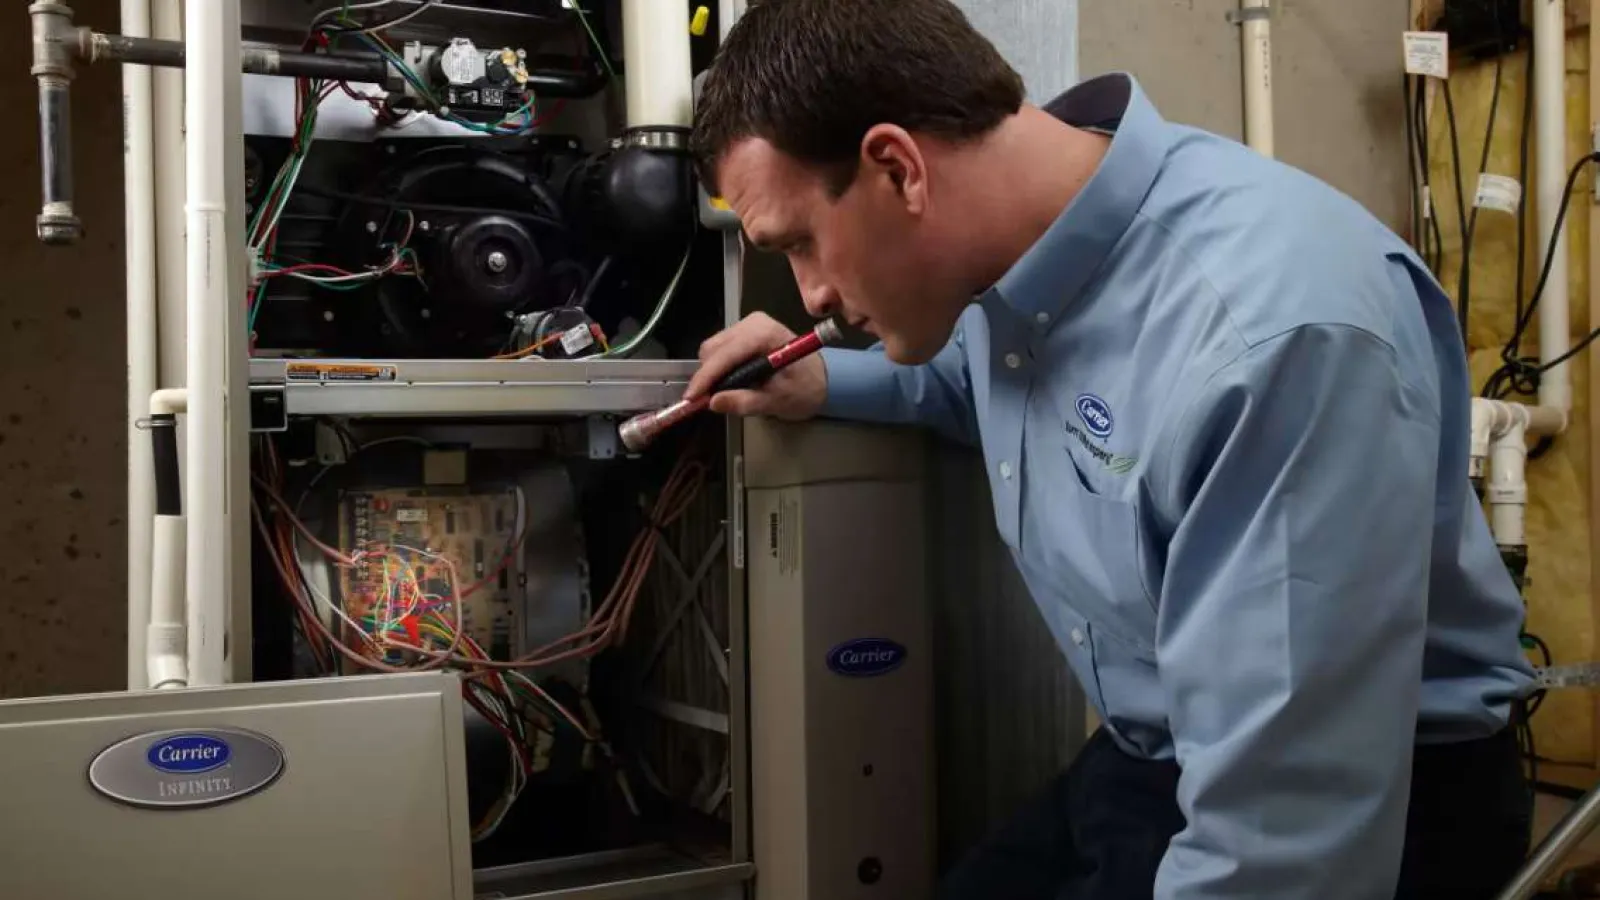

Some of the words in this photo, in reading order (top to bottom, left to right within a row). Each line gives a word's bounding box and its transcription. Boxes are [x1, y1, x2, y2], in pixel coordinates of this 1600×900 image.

[840, 646, 897, 665] Carrier
[158, 743, 222, 763] Carrier
[158, 776, 233, 798] INFINITY
